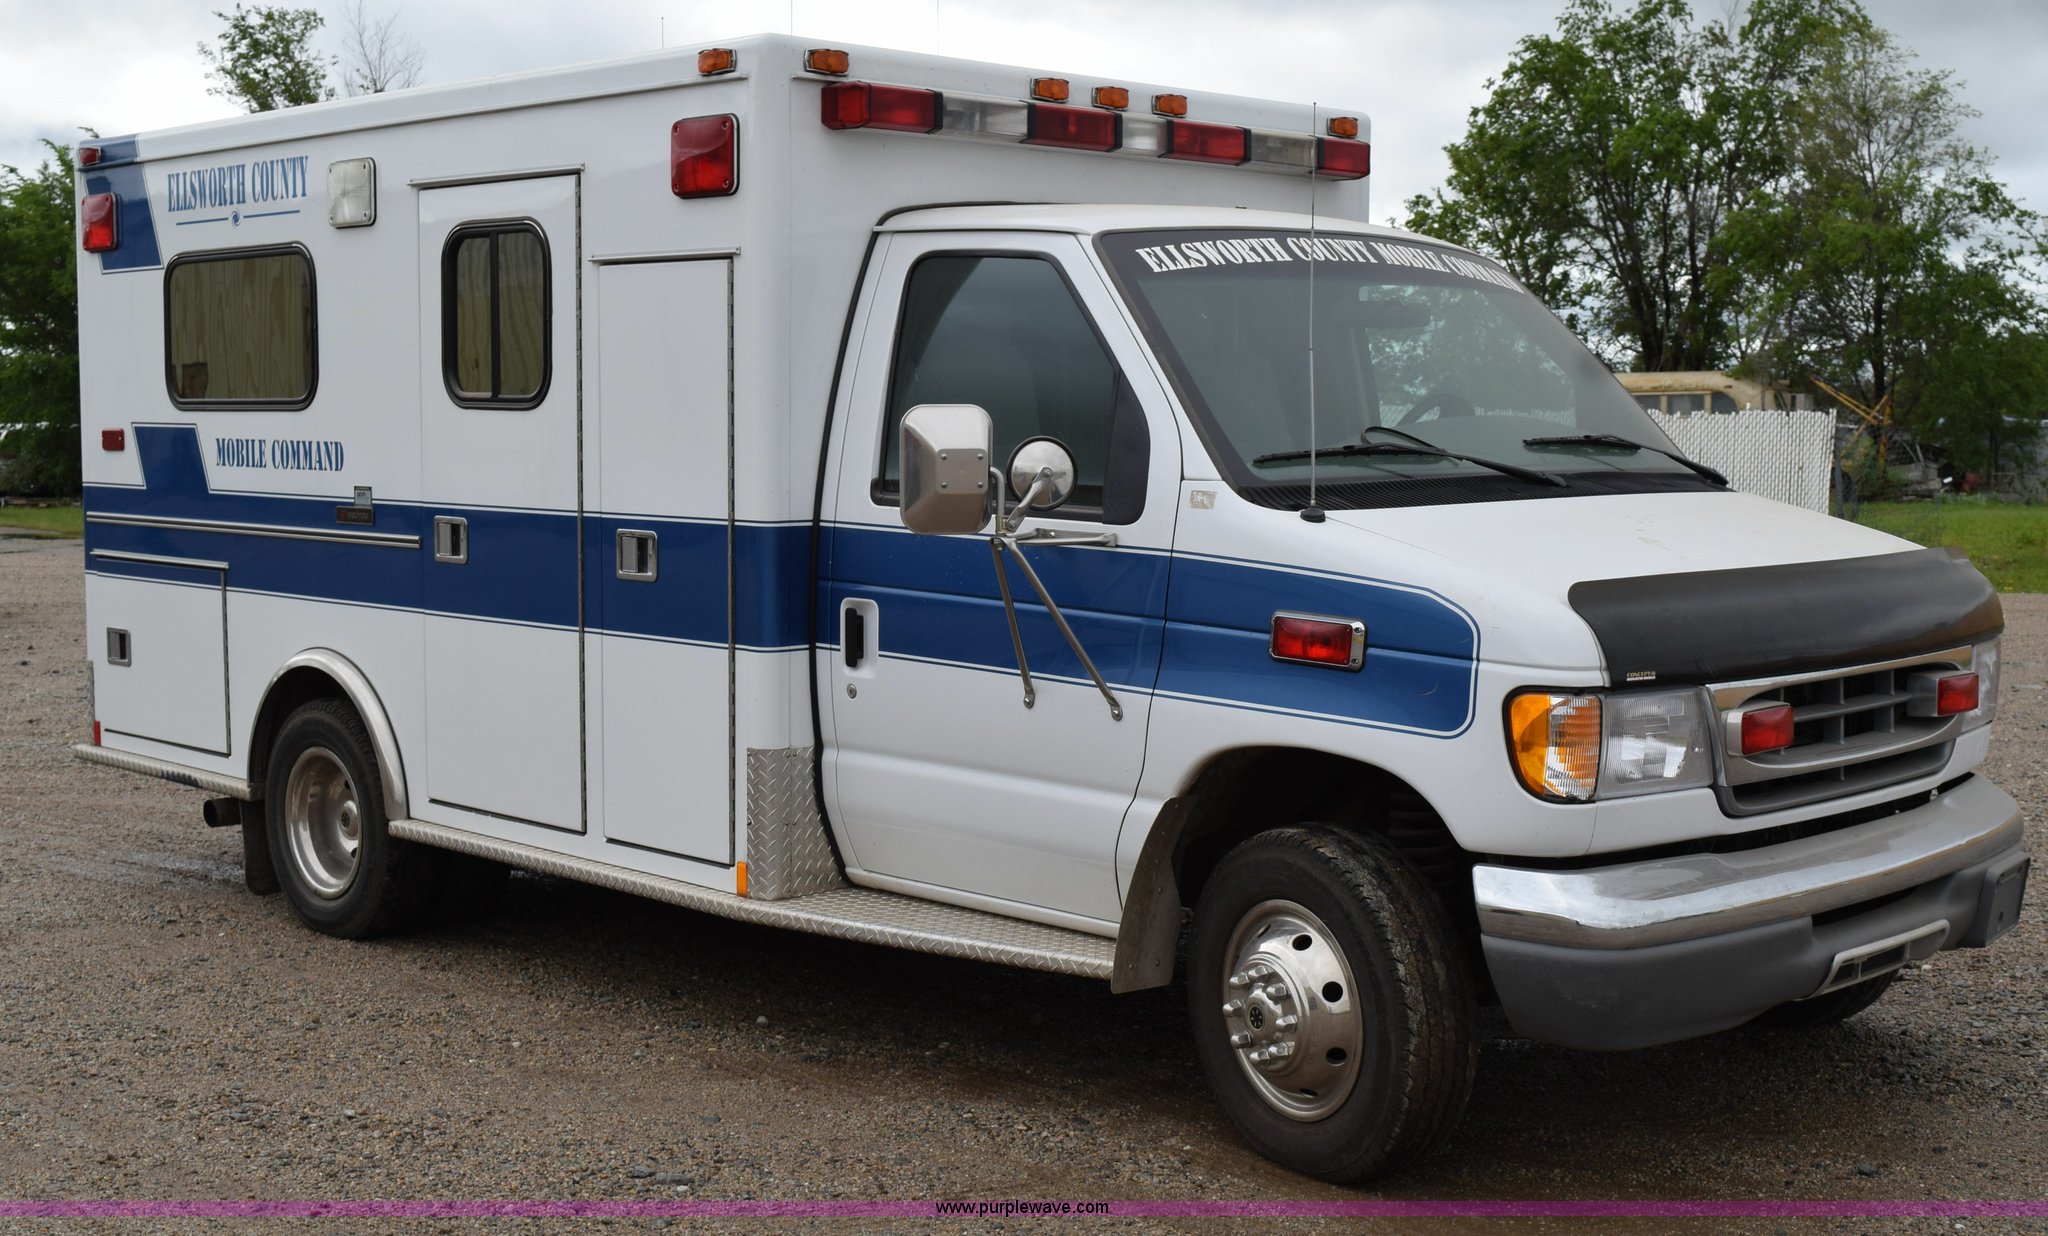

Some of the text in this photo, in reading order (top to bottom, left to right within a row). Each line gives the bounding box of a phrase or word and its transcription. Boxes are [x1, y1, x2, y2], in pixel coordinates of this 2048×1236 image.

[167, 155, 309, 212] ELLSWORTH COUNTY
[1135, 237, 1293, 272] ELLSWORTH
[1286, 237, 1378, 264] COUNTY
[1369, 241, 1451, 273] MOBILE
[216, 438, 345, 472] MOBILE COMMAND
